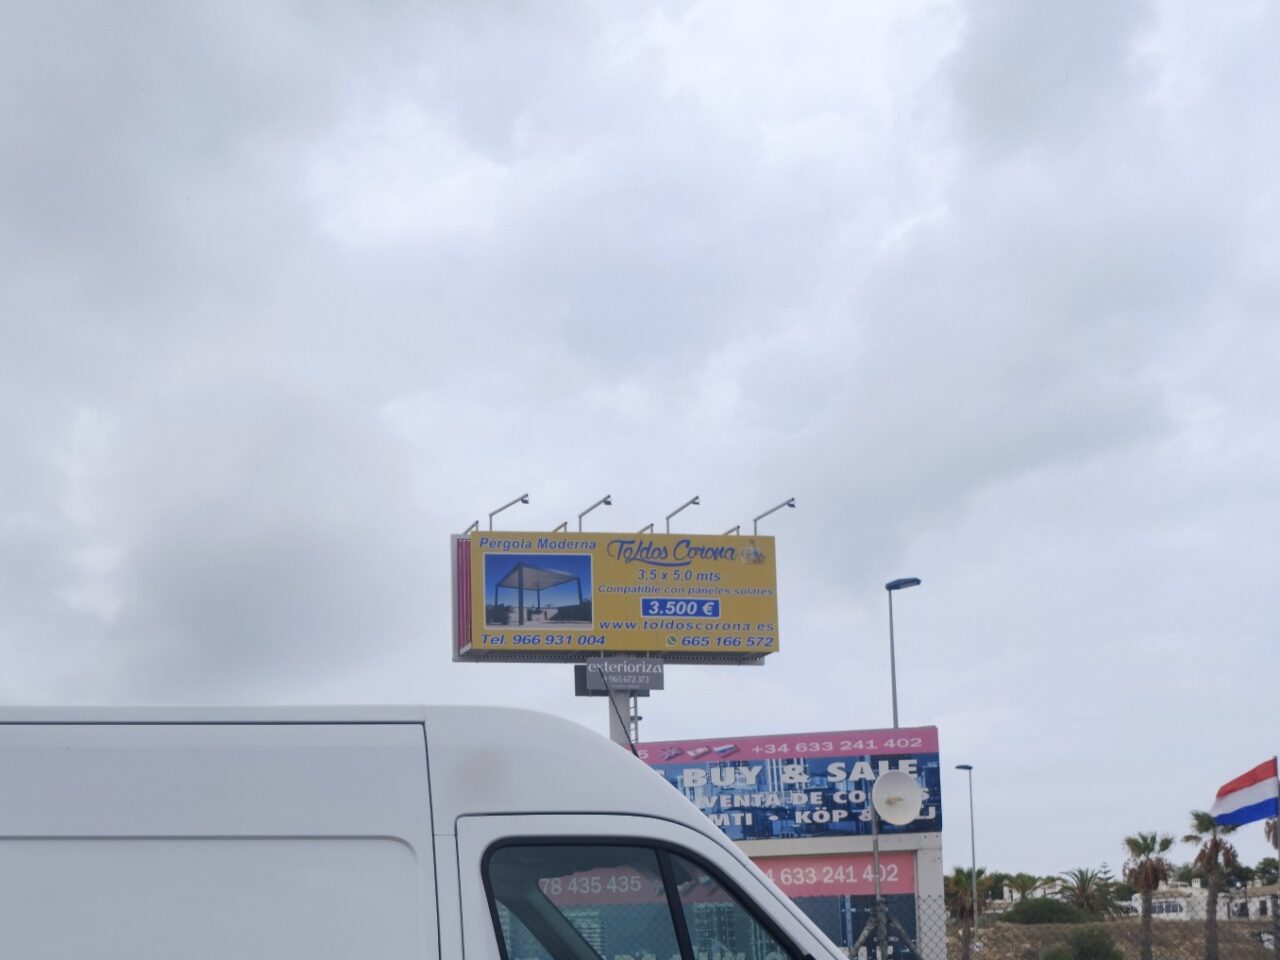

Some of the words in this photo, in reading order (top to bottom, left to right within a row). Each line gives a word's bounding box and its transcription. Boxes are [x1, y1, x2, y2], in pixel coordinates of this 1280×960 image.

[480, 538, 531, 551] Pergola
[537, 538, 596, 549] Moderna
[607, 539, 668, 563] Toldos
[673, 539, 737, 562] Corona
[696, 572, 721, 582] mts
[598, 584, 661, 595] Compatible
[687, 586, 730, 596] paneles
[734, 586, 774, 596] solares
[648, 601, 697, 615] 3.500
[702, 602, 715, 615] €
[512, 634, 541, 645] 966
[545, 635, 572, 645] 931
[577, 635, 606, 646] 004
[681, 636, 710, 647] 665
[715, 636, 742, 647] 166
[746, 636, 775, 648] 572
[752, 743, 789, 755] +34
[795, 741, 833, 753] 633
[840, 740, 877, 751] 241
[884, 738, 923, 749] 402
[683, 766, 763, 787] BUY
[781, 764, 811, 784] &
[703, 793, 782, 808] VENTA
[791, 791, 823, 805] DE
[795, 806, 848, 824] KÖP
[568, 877, 601, 894] 435
[607, 876, 641, 892] 435
[780, 867, 816, 885] 633
[822, 865, 857, 884] 241
